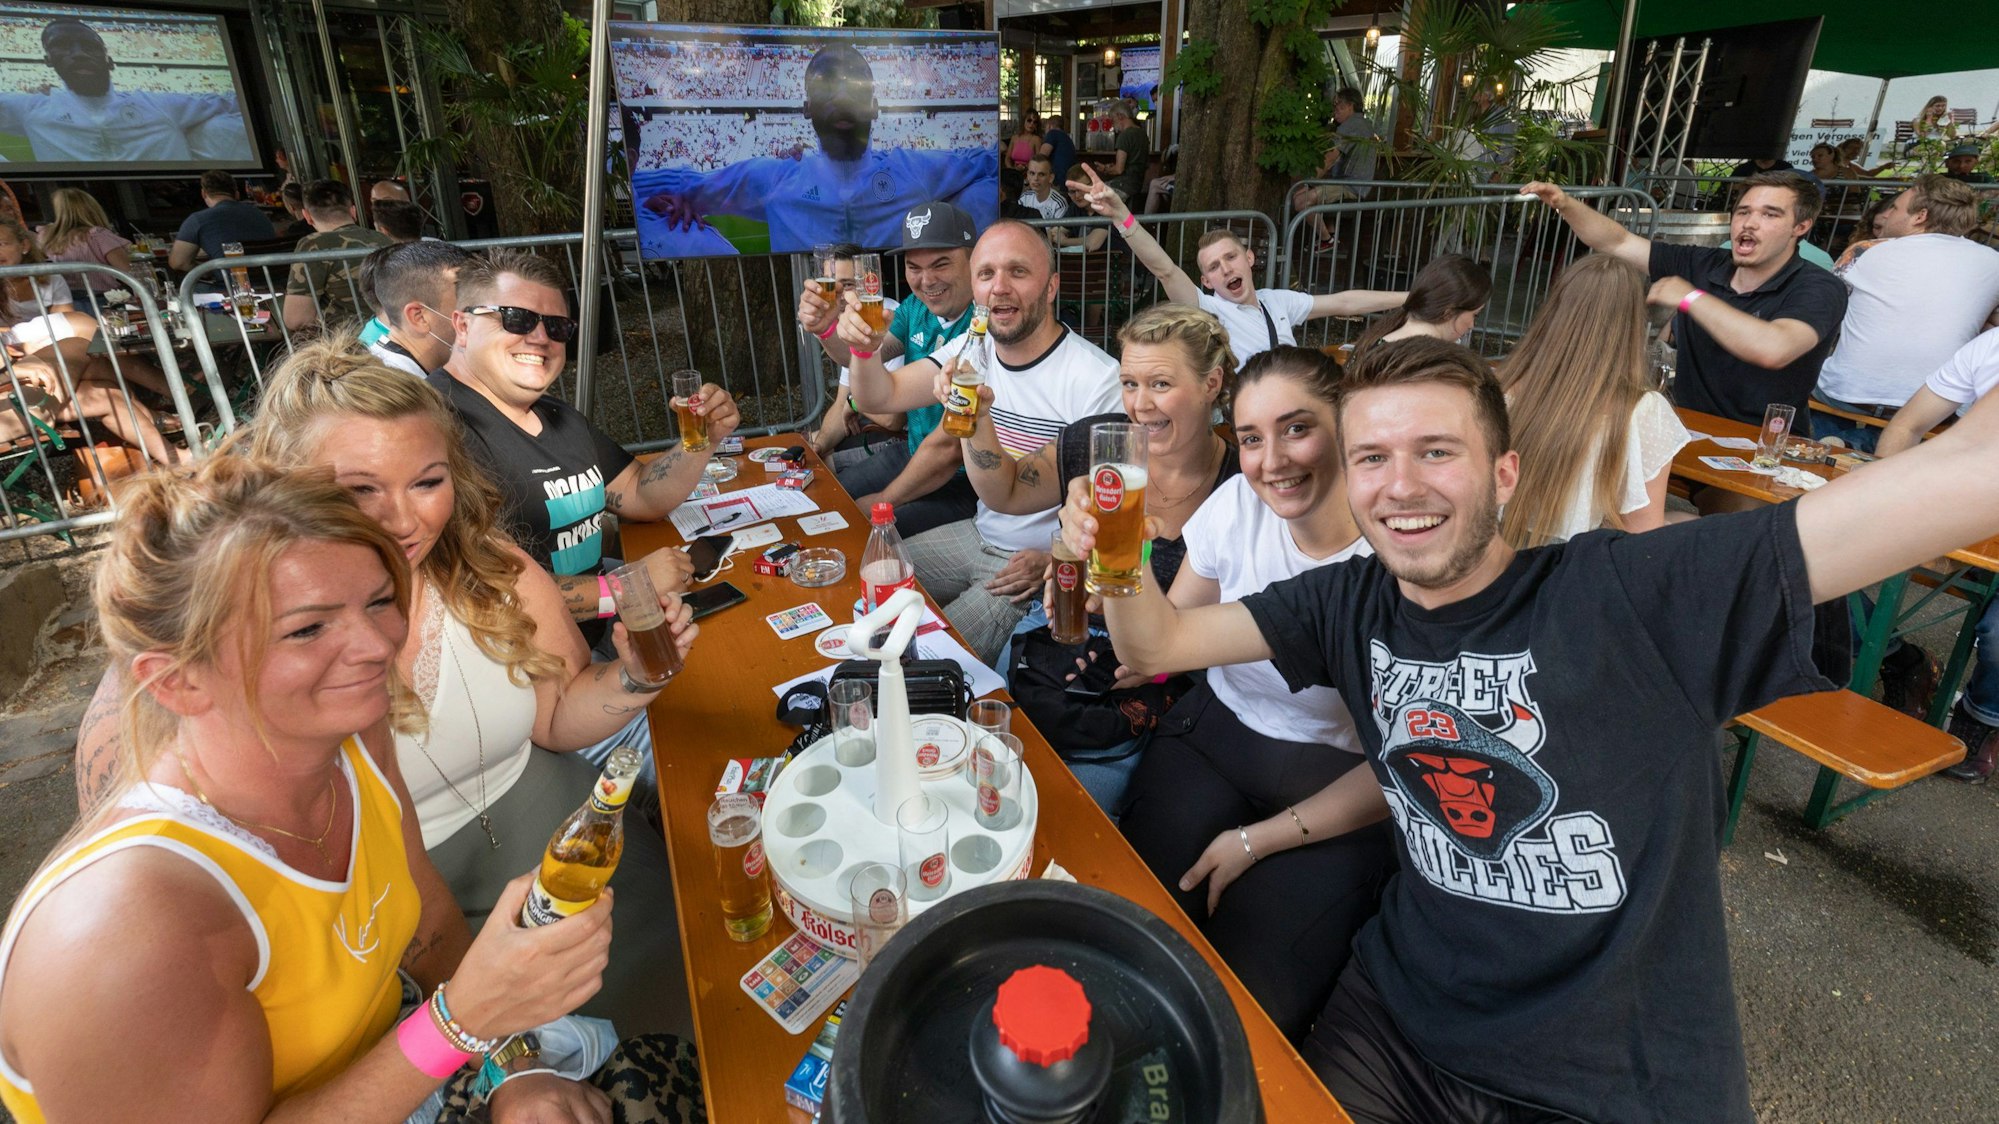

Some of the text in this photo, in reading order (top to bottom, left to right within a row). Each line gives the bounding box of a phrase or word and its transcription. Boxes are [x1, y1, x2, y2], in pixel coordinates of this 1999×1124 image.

[1791, 132, 1813, 141] gen
[1370, 638, 1538, 715] STREET
[1405, 709, 1461, 741] 23
[1382, 787, 1628, 914] BULLIES
[1142, 1063, 1171, 1124] Bra
